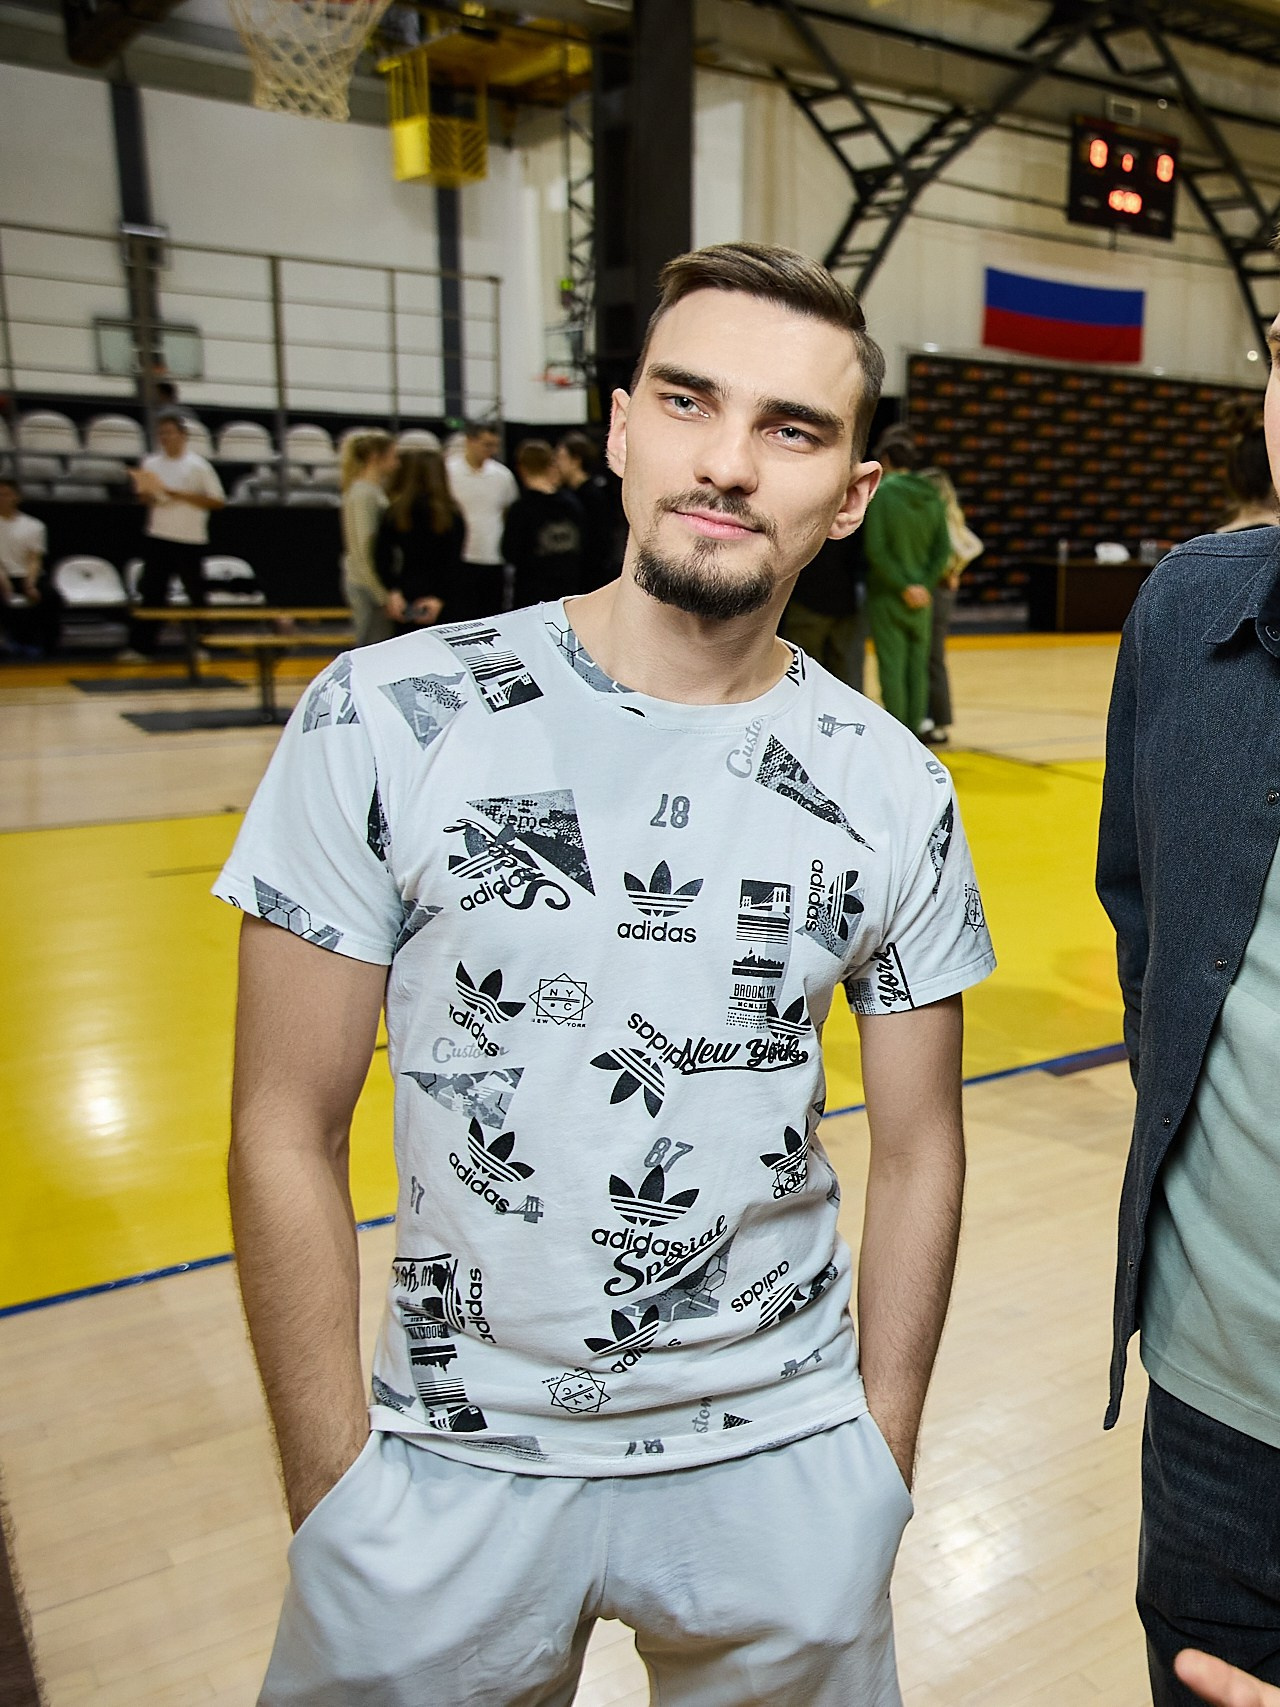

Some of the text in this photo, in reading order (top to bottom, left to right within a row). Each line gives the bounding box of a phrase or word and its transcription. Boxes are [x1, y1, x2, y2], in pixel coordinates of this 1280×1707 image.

[726, 719, 763, 779] Custo
[650, 793, 690, 829] 87
[805, 859, 826, 932] adidas
[617, 919, 697, 944] adidas
[733, 983, 776, 999] BROOKLYN
[432, 1037, 510, 1064] Custo
[627, 1012, 697, 1074] adidas
[644, 1136, 694, 1174] 87
[449, 1152, 510, 1213] adidas
[591, 1228, 686, 1257] adidas
[731, 1260, 790, 1312] adidas
